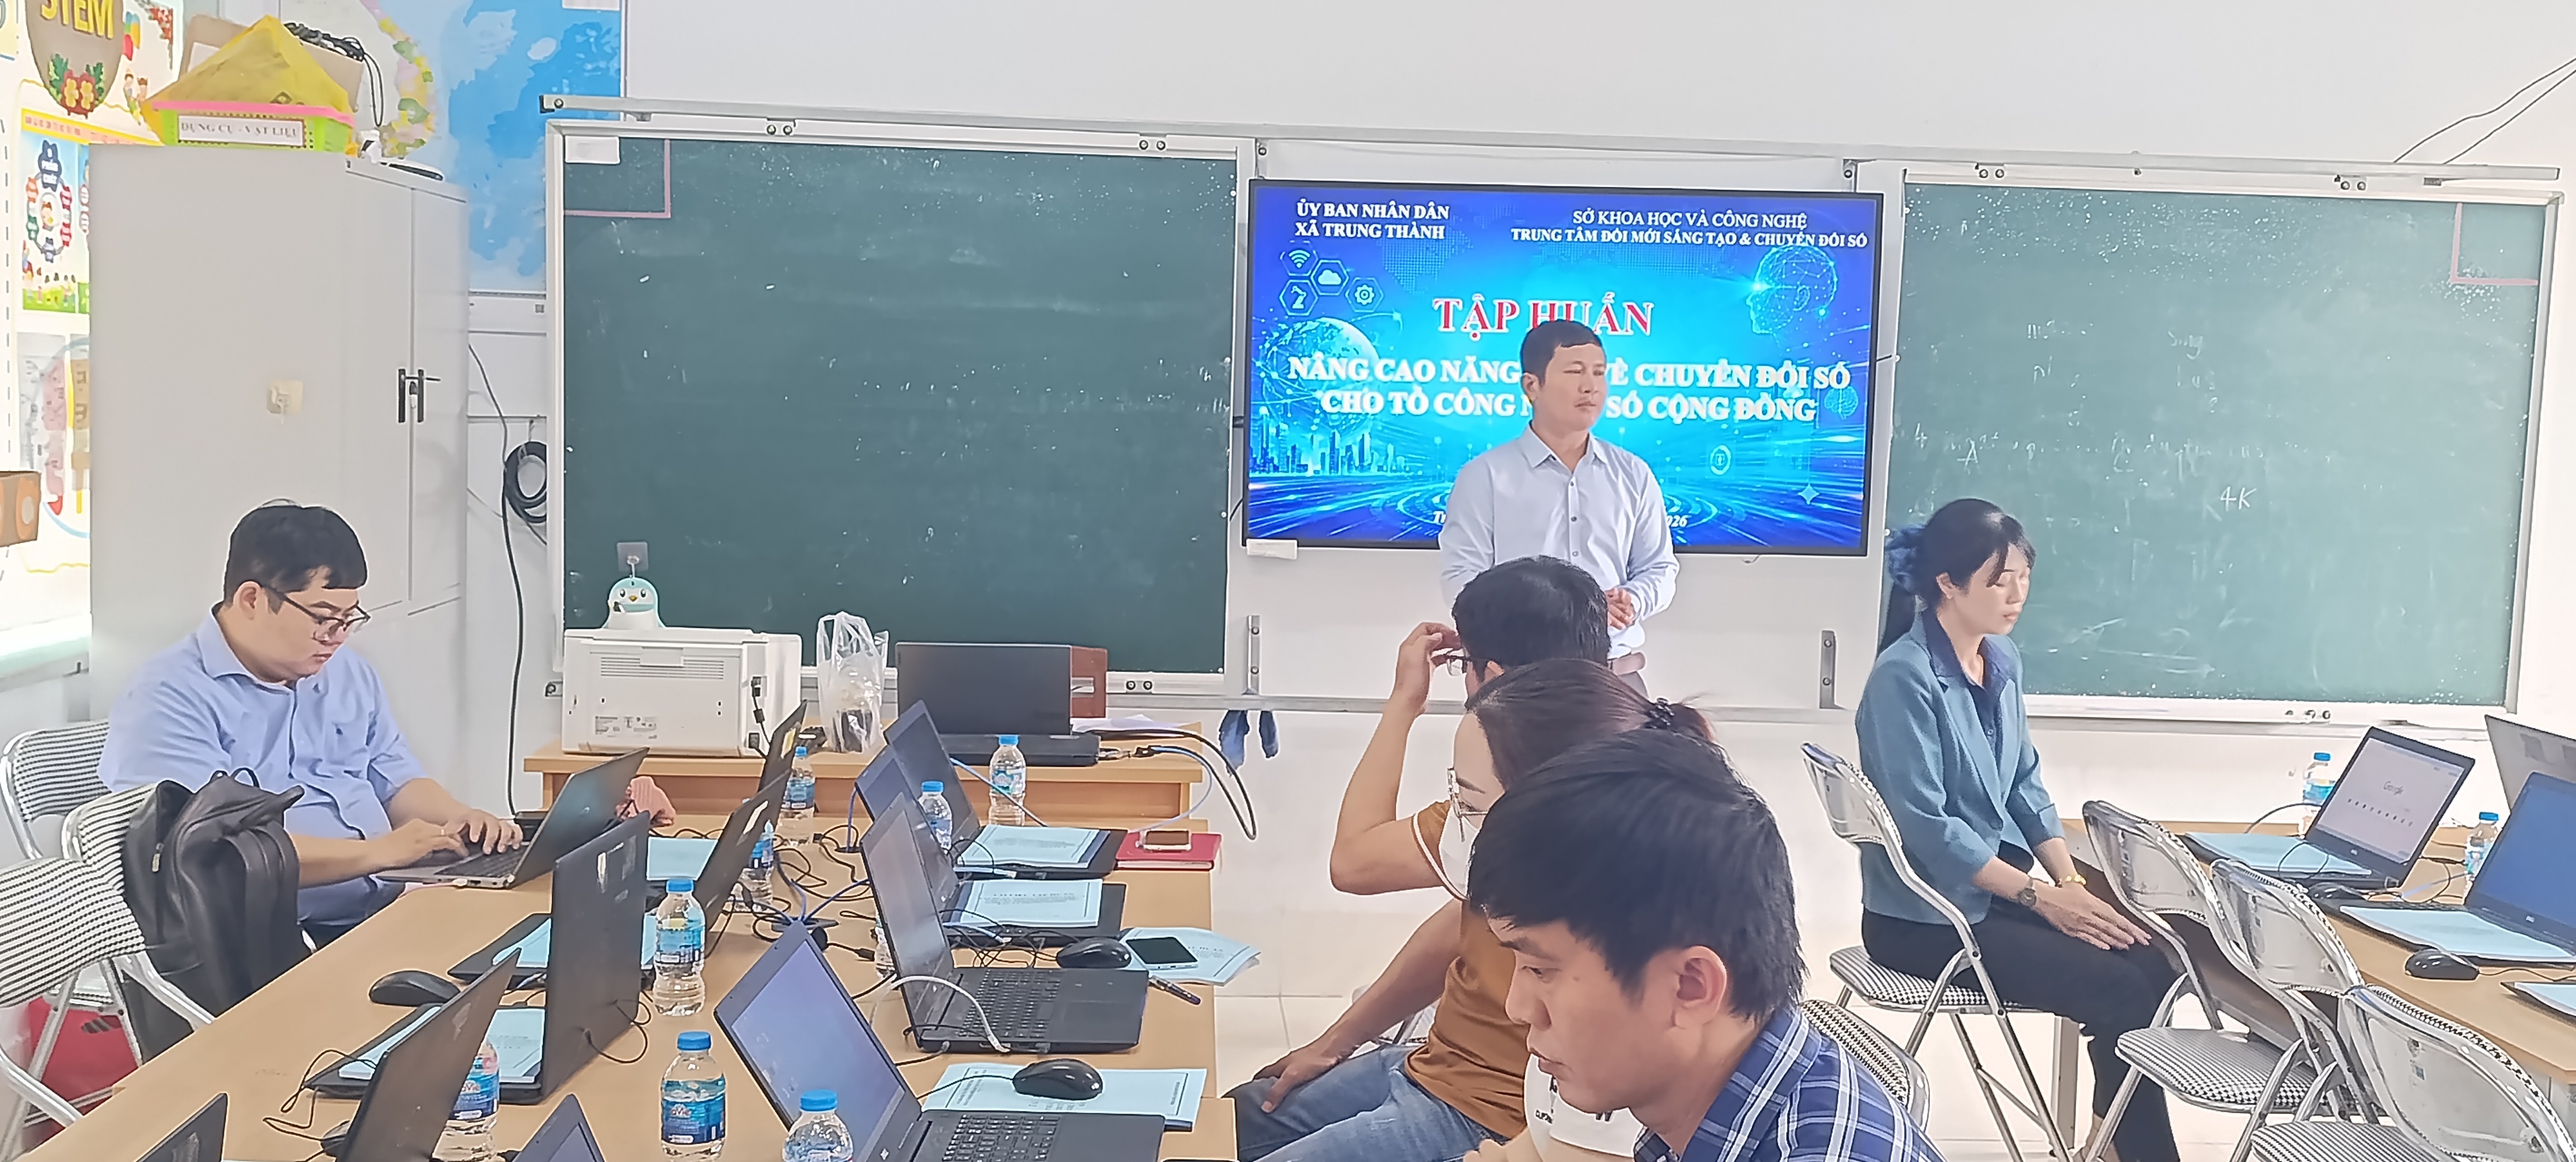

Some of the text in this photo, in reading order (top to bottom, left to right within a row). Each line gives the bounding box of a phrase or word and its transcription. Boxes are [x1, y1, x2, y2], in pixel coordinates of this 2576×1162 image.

[1296, 198, 1450, 220] ỦY BAN NHÂN DÂN
[1572, 207, 1808, 231] SỞ KHOA HỌC VÀ CÔNG NGHỆ
[1295, 219, 1445, 239] XÃ TRUNG THÀNH
[1511, 228, 1563, 242] TRUNG
[1565, 227, 1598, 243] TÂM
[1663, 228, 1703, 245] SÁNG
[1705, 232, 1737, 248] TẠO
[1739, 234, 1751, 246] &
[1433, 291, 1655, 342] TẬP HUẤN
[1287, 351, 1369, 381] NÂNG
[1373, 358, 1436, 383] CAO
[1440, 355, 1520, 384] NĂNG
[1320, 388, 1385, 415] CHO
[1433, 386, 1516, 417] CÔNG
[1647, 393, 1731, 425] CỘNG
[2219, 486, 2257, 512] 4K
[1666, 515, 1692, 527] 026
